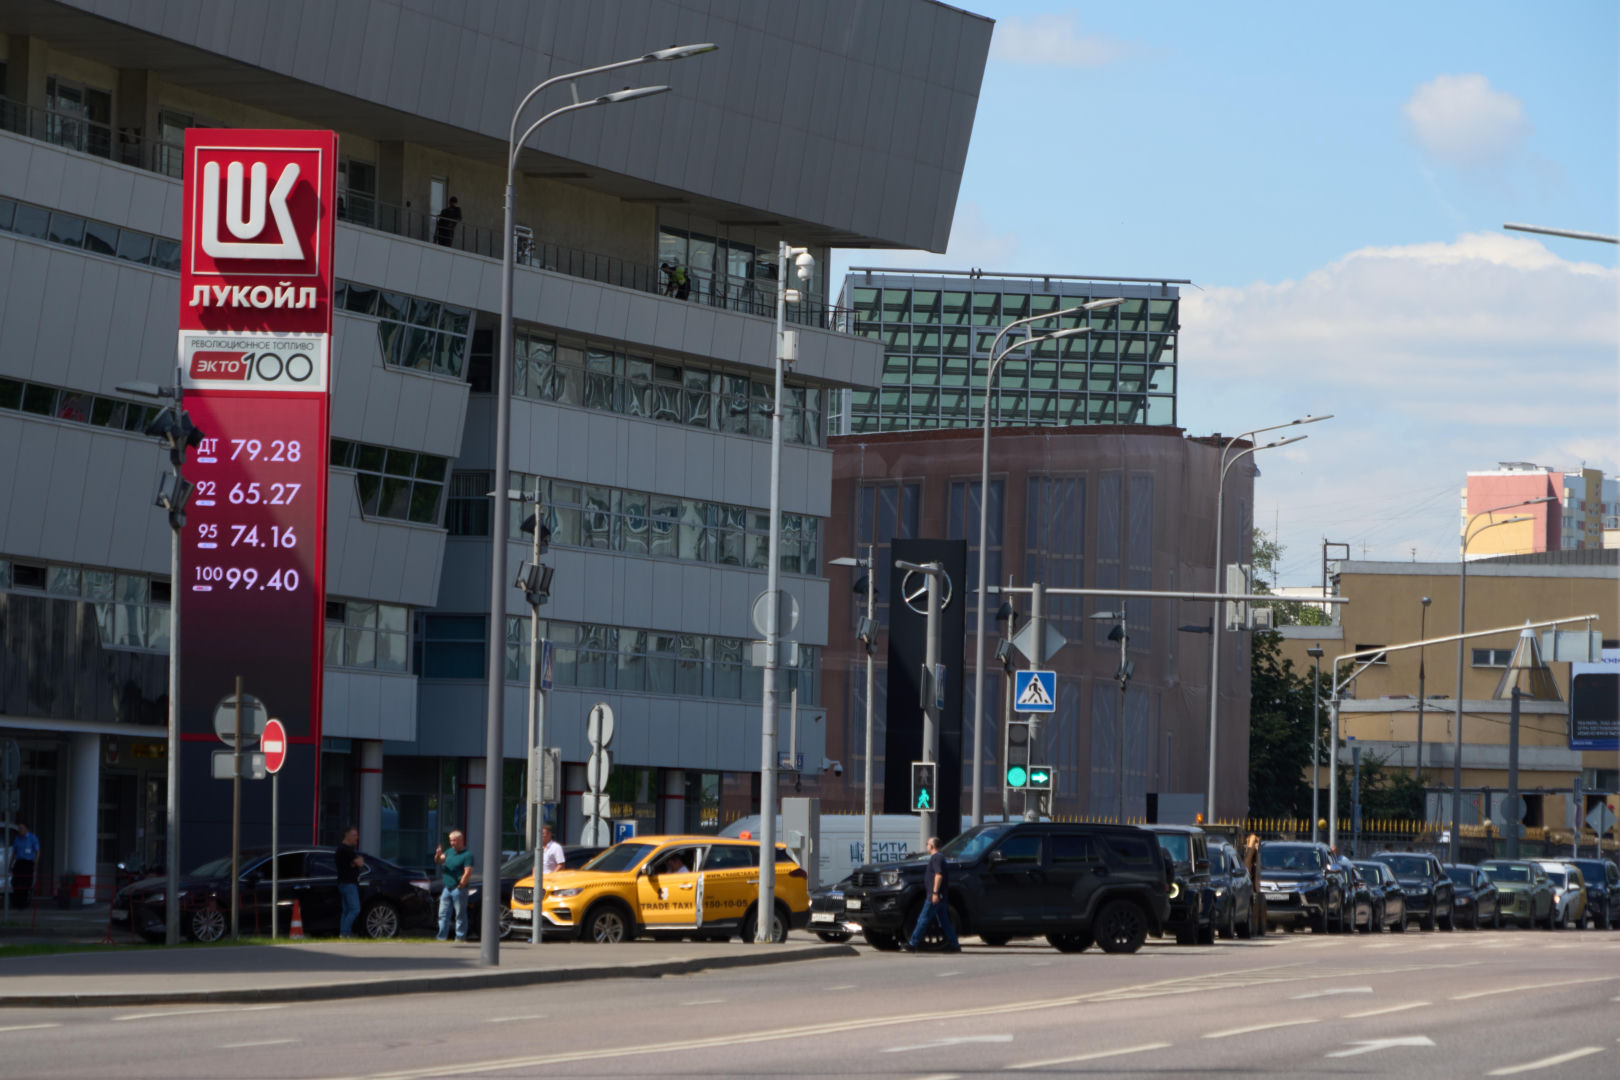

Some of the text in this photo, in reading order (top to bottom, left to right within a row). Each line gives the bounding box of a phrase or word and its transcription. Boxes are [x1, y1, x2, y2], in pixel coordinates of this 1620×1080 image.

[189, 281, 317, 309] ЛУКОЙЛ
[191, 340, 314, 351] РЕВОЛЮЦИОННОЕ ТОПЛИВО
[196, 352, 313, 382] ЭКТО 100
[197, 438, 301, 463] ДТ 79.28
[196, 481, 302, 505] 92 65.27
[198, 523, 297, 549] 95 74.16
[195, 566, 299, 591] 100 99.40
[641, 902, 693, 910] TRADE TAXI
